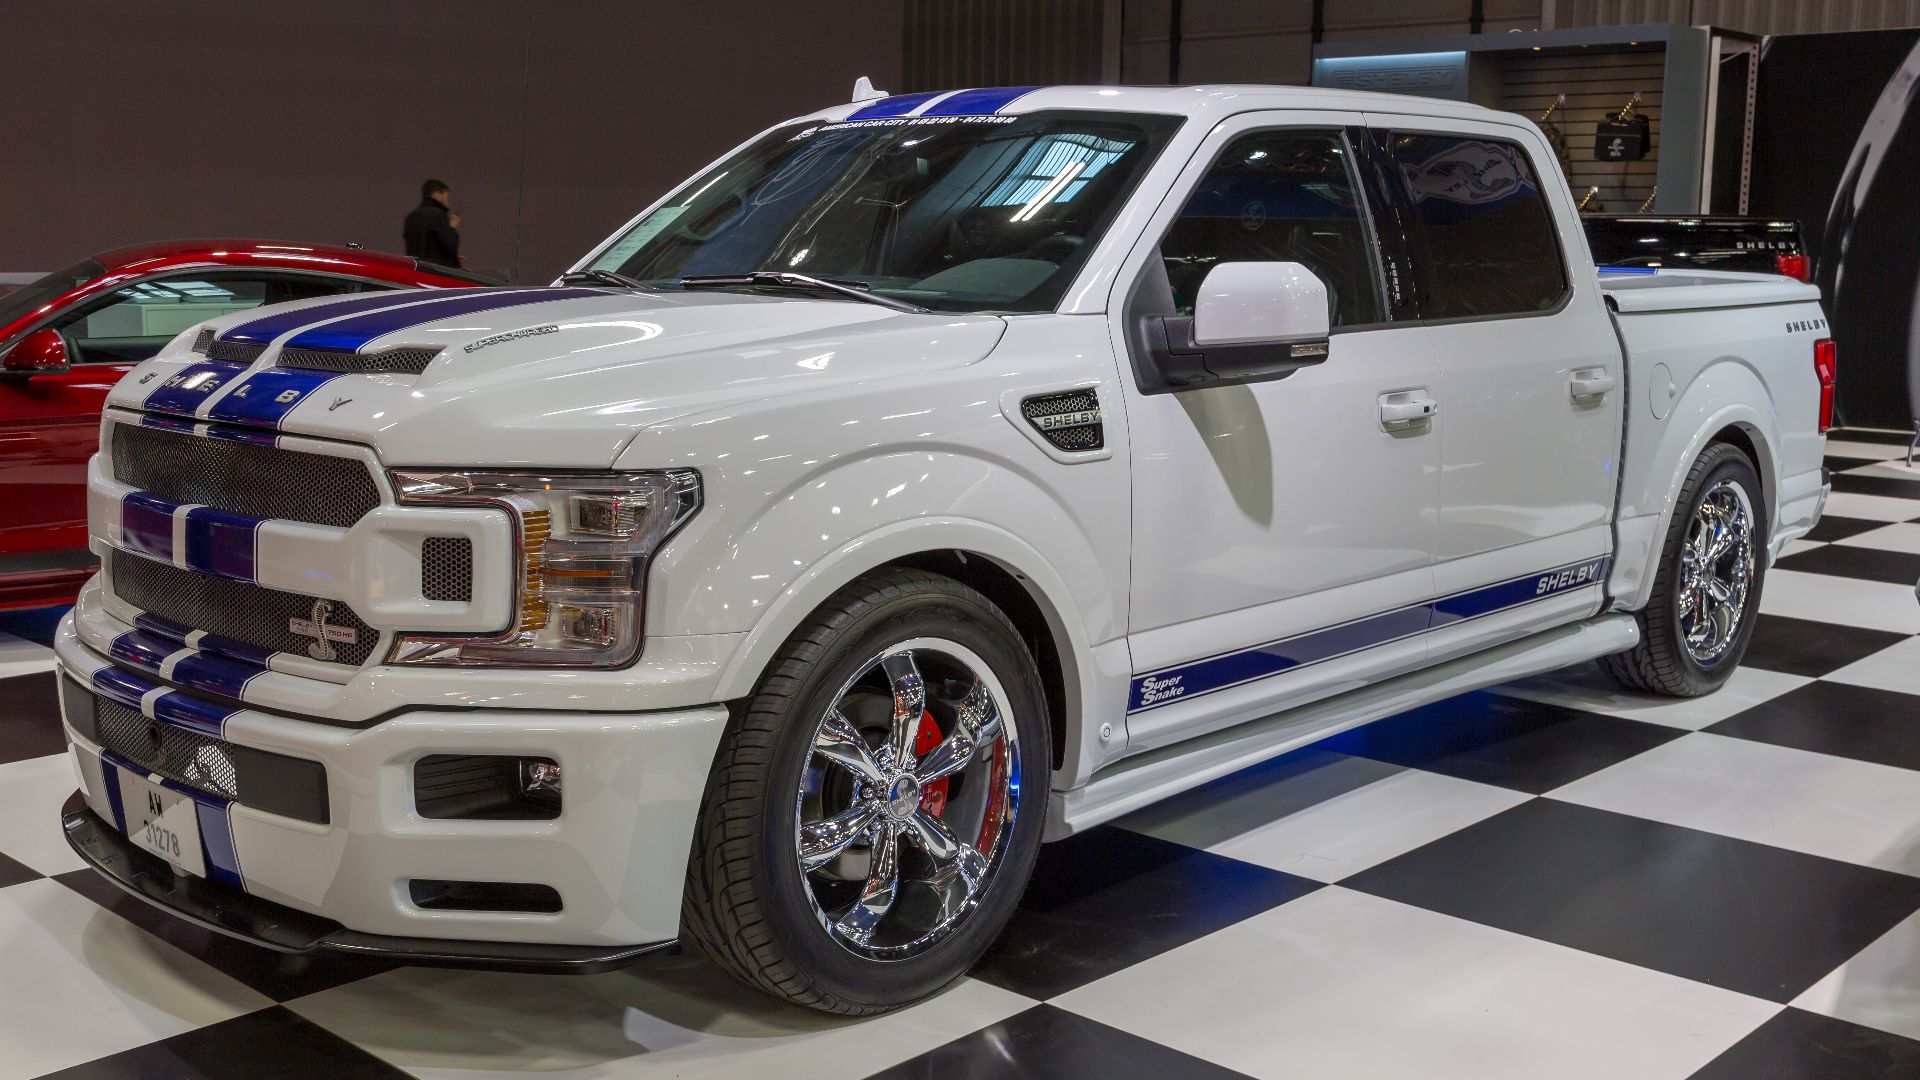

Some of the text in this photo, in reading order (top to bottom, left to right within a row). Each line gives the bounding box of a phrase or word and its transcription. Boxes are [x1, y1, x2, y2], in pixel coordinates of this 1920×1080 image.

[885, 119, 908, 127] CITY
[1736, 241, 1796, 249] SHELBY
[1786, 319, 1827, 334] SHELBY
[464, 325, 559, 353] SUPERCHARGED
[139, 371, 353, 412] SHELBY
[1043, 411, 1099, 428] SHELBY
[1536, 563, 1599, 594] SHELBY
[327, 629, 341, 637] 750
[1141, 675, 1183, 693] Super
[1141, 687, 1185, 705] Snake
[143, 819, 181, 858] 31278
